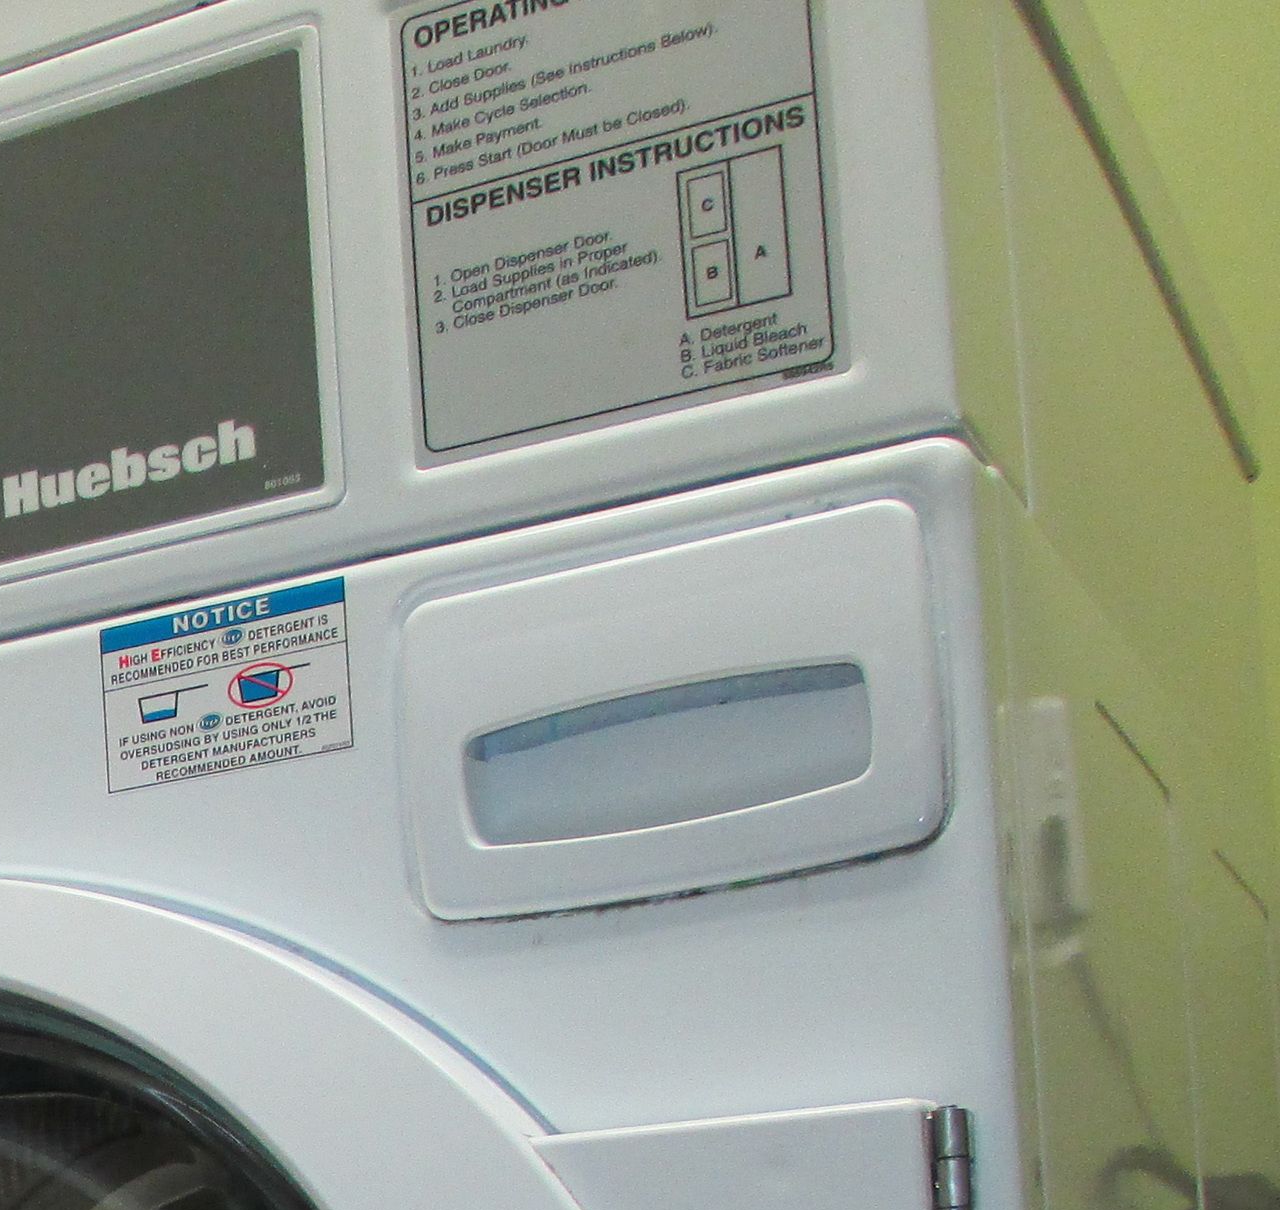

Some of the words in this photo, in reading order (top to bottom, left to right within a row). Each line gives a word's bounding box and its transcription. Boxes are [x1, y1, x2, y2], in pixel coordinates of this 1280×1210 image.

[428, 51, 463, 73] Load
[467, 36, 528, 62] Laundry.
[429, 74, 470, 94] Close
[474, 62, 511, 81] Door.
[430, 96, 459, 115] Add
[464, 80, 526, 106] Supplies
[531, 68, 565, 88] (See
[569, 41, 656, 75] Instructions
[661, 22, 718, 48] Below).
[432, 118, 470, 137] Make
[474, 105, 515, 124] Cycle
[520, 84, 591, 112] Selection.
[433, 139, 472, 158] Make
[476, 118, 541, 146] Payment.
[434, 160, 474, 180] Press
[478, 148, 512, 167] Start
[517, 136, 558, 157] (Door
[562, 124, 598, 144] Must
[603, 118, 622, 132] be
[626, 98, 690, 125] Closed).
[427, 167, 580, 227] DISPENSER
[590, 106, 805, 181] INSTRUCTIONS
[701, 198, 713, 212] C
[450, 263, 490, 282] Open
[495, 241, 569, 271] Dispenser
[574, 232, 612, 249] Door.
[452, 277, 487, 298] Load
[493, 262, 555, 287] Supplies
[560, 258, 573, 269] in
[578, 243, 628, 265] Proper
[706, 266, 718, 280] B
[755, 245, 767, 260] A
[452, 277, 551, 313] Compartment
[556, 272, 579, 289] (as
[584, 251, 661, 279] Indicated).
[453, 310, 495, 329] Close
[499, 289, 574, 318] Dispenser
[578, 279, 616, 297] Door.
[679, 332, 694, 347] A.
[700, 312, 777, 342] Detergent
[680, 348, 696, 363] B.
[701, 333, 749, 358] Liquid
[753, 322, 807, 347] Bleach
[681, 364, 698, 379] C.
[704, 353, 752, 374] Fabric
[757, 337, 825, 361] Softener
[2, 419, 256, 518] Huebsch
[173, 597, 269, 633] NOTICE
[111, 658, 194, 685] RECOMMENDED
[197, 653, 219, 667] FOR
[222, 646, 250, 662] BEST
[253, 627, 338, 655] PERFORMANCE
[119, 653, 148, 669] HIGH
[151, 638, 215, 662] EFFICIENCY
[248, 616, 314, 641] DETERGENT
[318, 614, 328, 626] IS
[119, 737, 129, 747] IF
[132, 730, 166, 745] USING
[170, 723, 194, 737] NON
[302, 695, 336, 711] AVOID
[120, 737, 201, 760] OVERSUDSING
[204, 732, 219, 744] BY
[223, 725, 258, 740] USING
[262, 718, 292, 732] ONLY
[297, 714, 311, 725] 1/2
[313, 709, 336, 722] THE
[141, 748, 209, 771] DETERGENT
[212, 728, 316, 756] MANUFACTURERS
[156, 755, 246, 781] RECOMMENDED
[249, 745, 302, 763] AMOUNT.
